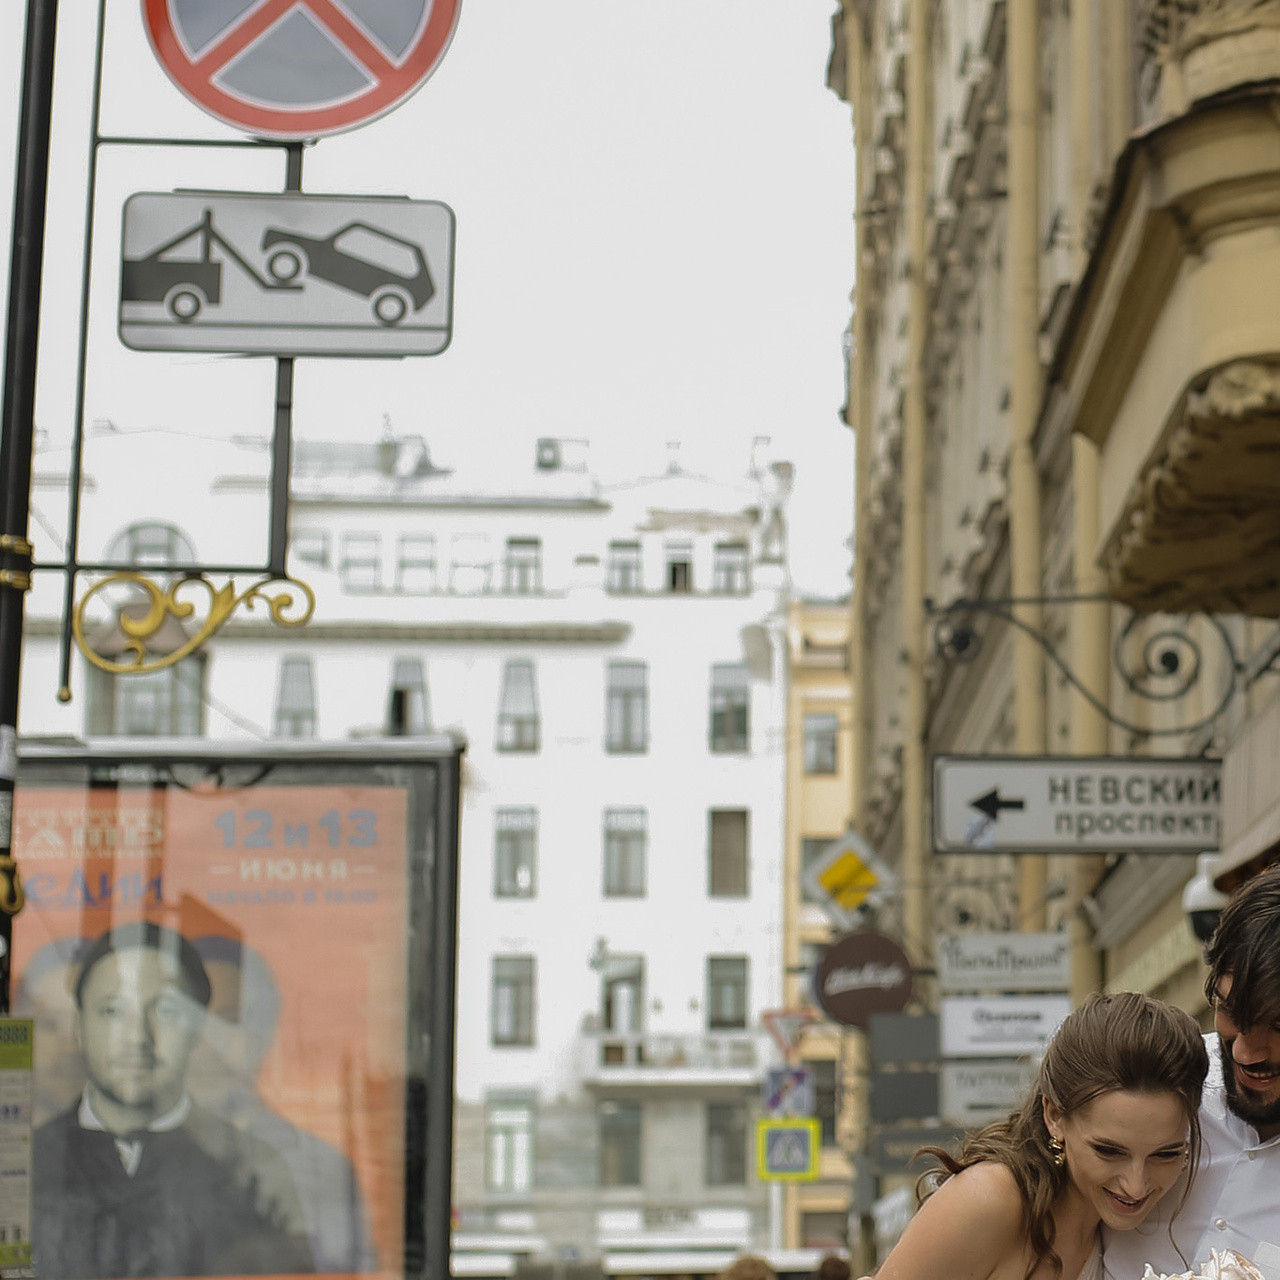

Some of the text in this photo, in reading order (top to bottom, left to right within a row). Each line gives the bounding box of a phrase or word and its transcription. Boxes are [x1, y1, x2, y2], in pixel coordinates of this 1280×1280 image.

[1048, 773, 1221, 805] НЕВСКИЙ
[214, 809, 274, 848] 12
[318, 809, 378, 848] 13
[1055, 812, 1212, 842] проспект
[239, 857, 348, 881] ИЮНЯ
[208, 889, 296, 905] НАЧАЛО
